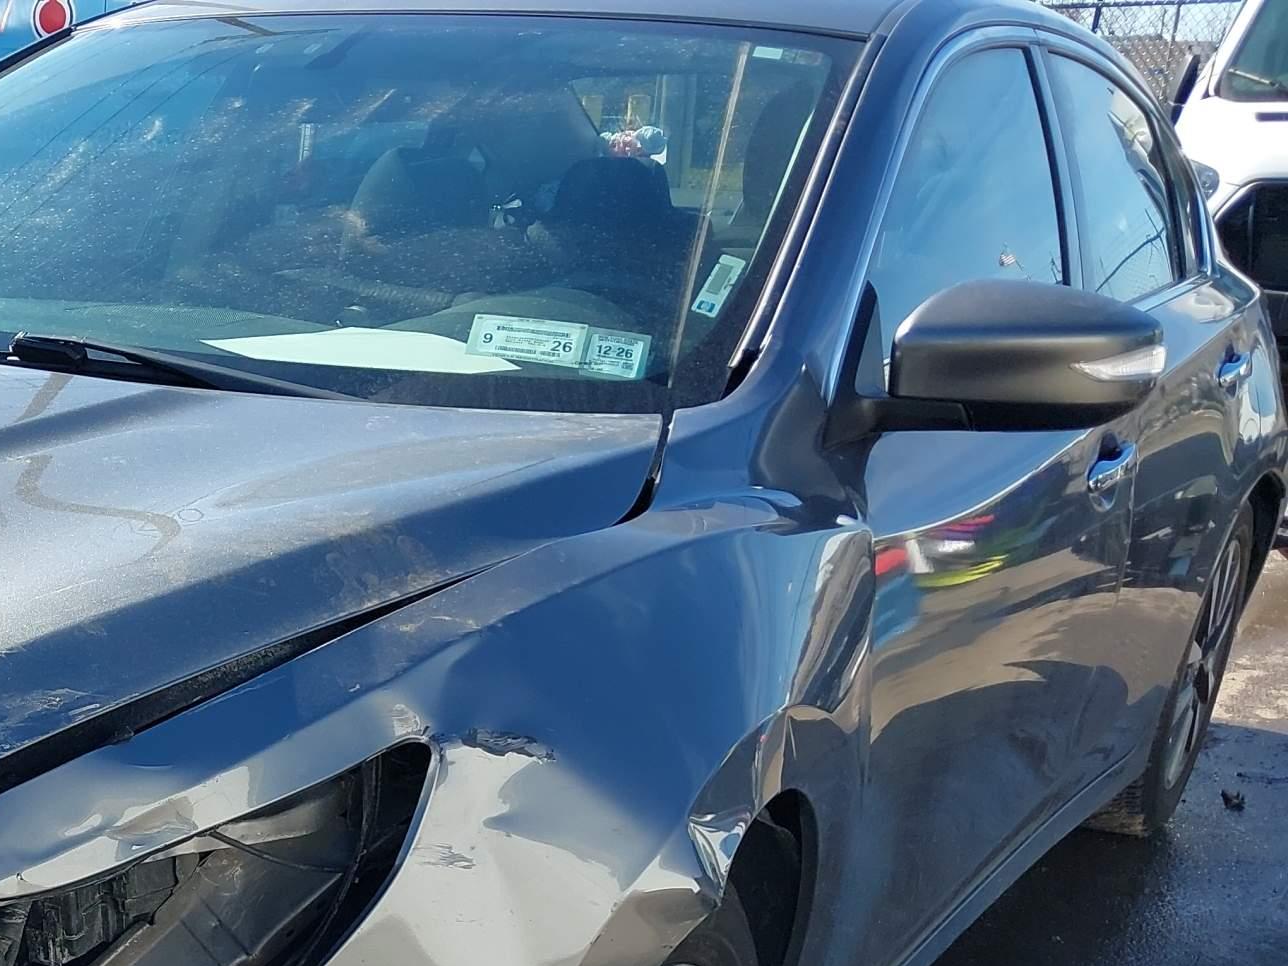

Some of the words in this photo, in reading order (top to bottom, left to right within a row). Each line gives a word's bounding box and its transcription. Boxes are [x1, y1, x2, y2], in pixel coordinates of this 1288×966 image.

[482, 333, 494, 344] 9
[551, 340, 574, 353] 26
[596, 344, 634, 359] 12-26
